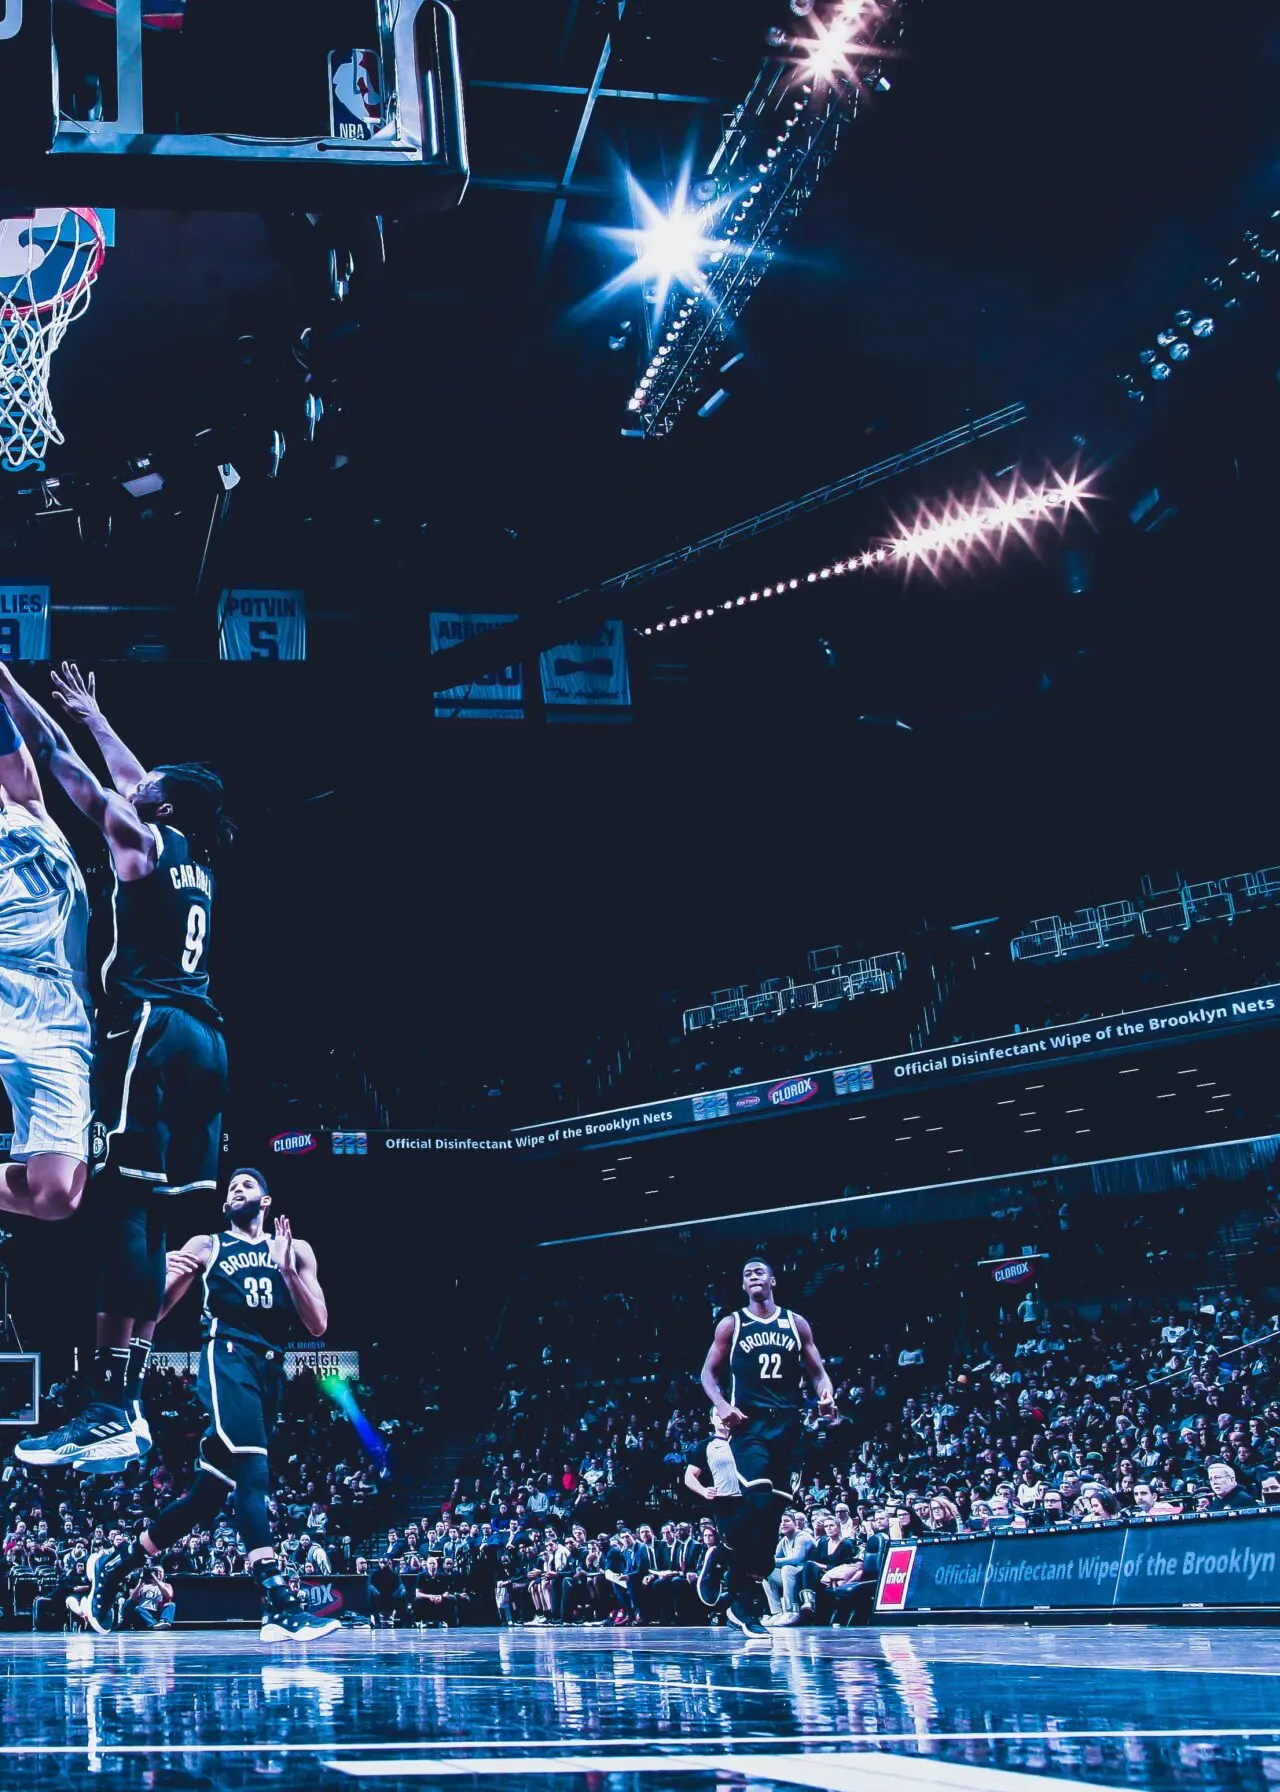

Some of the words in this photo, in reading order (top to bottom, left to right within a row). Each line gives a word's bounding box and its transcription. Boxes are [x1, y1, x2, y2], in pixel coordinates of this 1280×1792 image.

[339, 122, 365, 140] NBA
[224, 597, 296, 618] POTVIN
[248, 621, 280, 661] 5
[181, 904, 207, 974] 9
[894, 1056, 948, 1078] Official
[951, 1039, 1047, 1067] Disinfectant
[1049, 1032, 1092, 1049] Wipe
[1095, 1025, 1113, 1041] of
[1116, 1021, 1145, 1037] the
[1148, 1008, 1228, 1032] Brooklyn
[1232, 997, 1276, 1016] Nets
[772, 1077, 813, 1105] CLOROX
[223, 1133, 229, 1142] 3
[385, 1138, 432, 1149] Official
[435, 1138, 513, 1149] Disinfectant
[515, 1134, 545, 1148] Wipe
[547, 1129, 561, 1142] of
[563, 1127, 583, 1139] the
[585, 1117, 641, 1136] Brooklyn
[643, 1111, 673, 1125] Nets
[273, 1133, 313, 1153] CLOROX
[219, 1251, 282, 1276] BROOKL
[994, 1261, 1029, 1282] CLOROX
[243, 1276, 274, 1309] 33
[739, 1330, 796, 1354] BROOKLYN
[294, 1355, 316, 1367] WE
[320, 1354, 340, 1367] GO
[758, 1353, 783, 1379] 22
[885, 1568, 908, 1585] infor
[934, 1561, 981, 1586] Official
[984, 1559, 1075, 1584] Disinfectant
[1077, 1555, 1120, 1586] Wipe
[1123, 1553, 1145, 1578] of
[1146, 1552, 1177, 1577] the
[1182, 1546, 1276, 1581] Brooklyn
